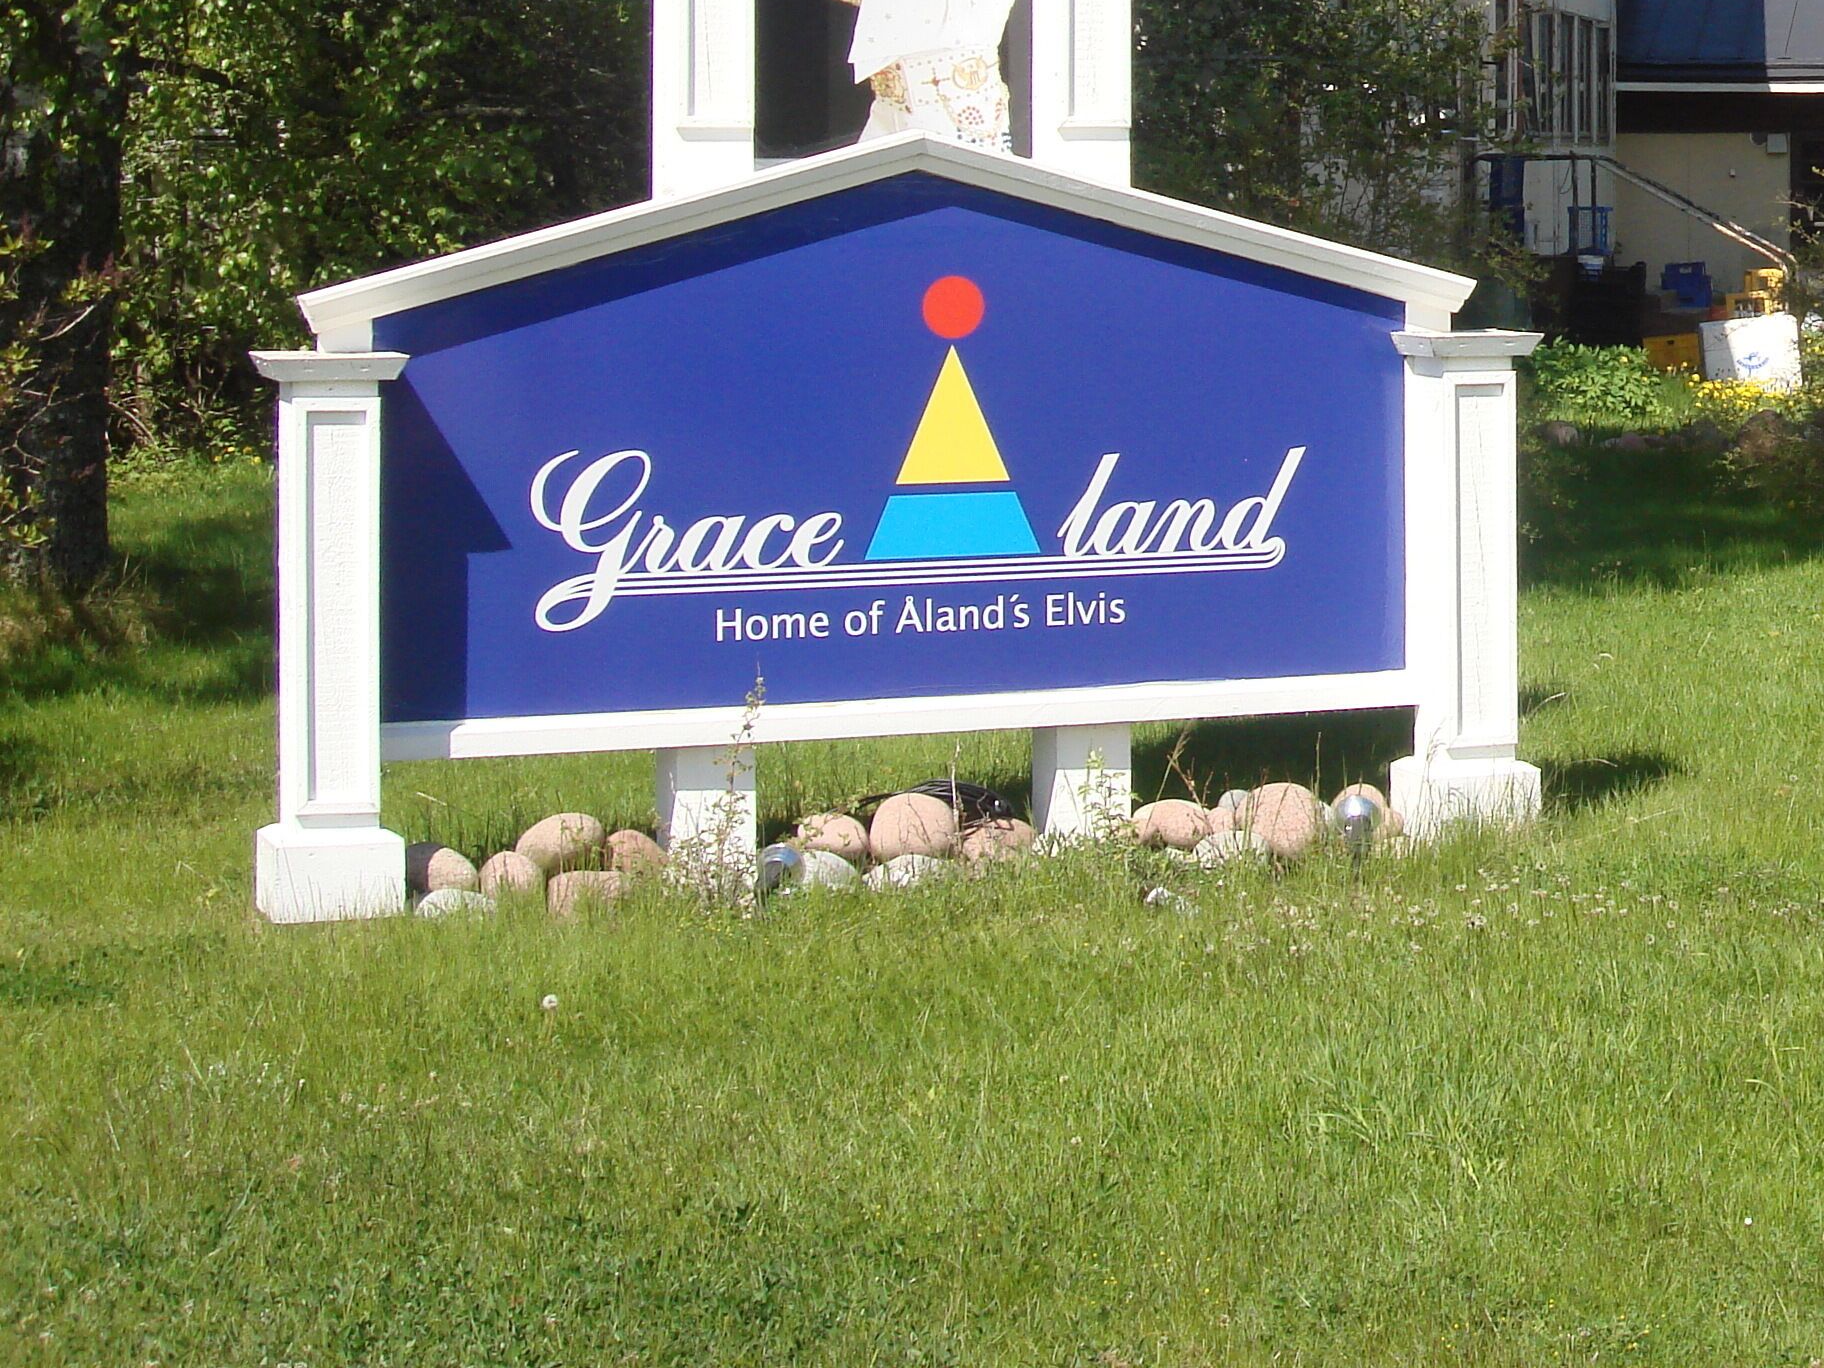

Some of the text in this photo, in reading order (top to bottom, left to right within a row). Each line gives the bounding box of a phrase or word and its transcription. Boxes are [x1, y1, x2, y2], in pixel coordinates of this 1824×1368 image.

[529, 445, 1307, 632] Grace land
[715, 607, 830, 642] Home
[843, 599, 886, 636] of
[1046, 591, 1127, 627] Elvis
